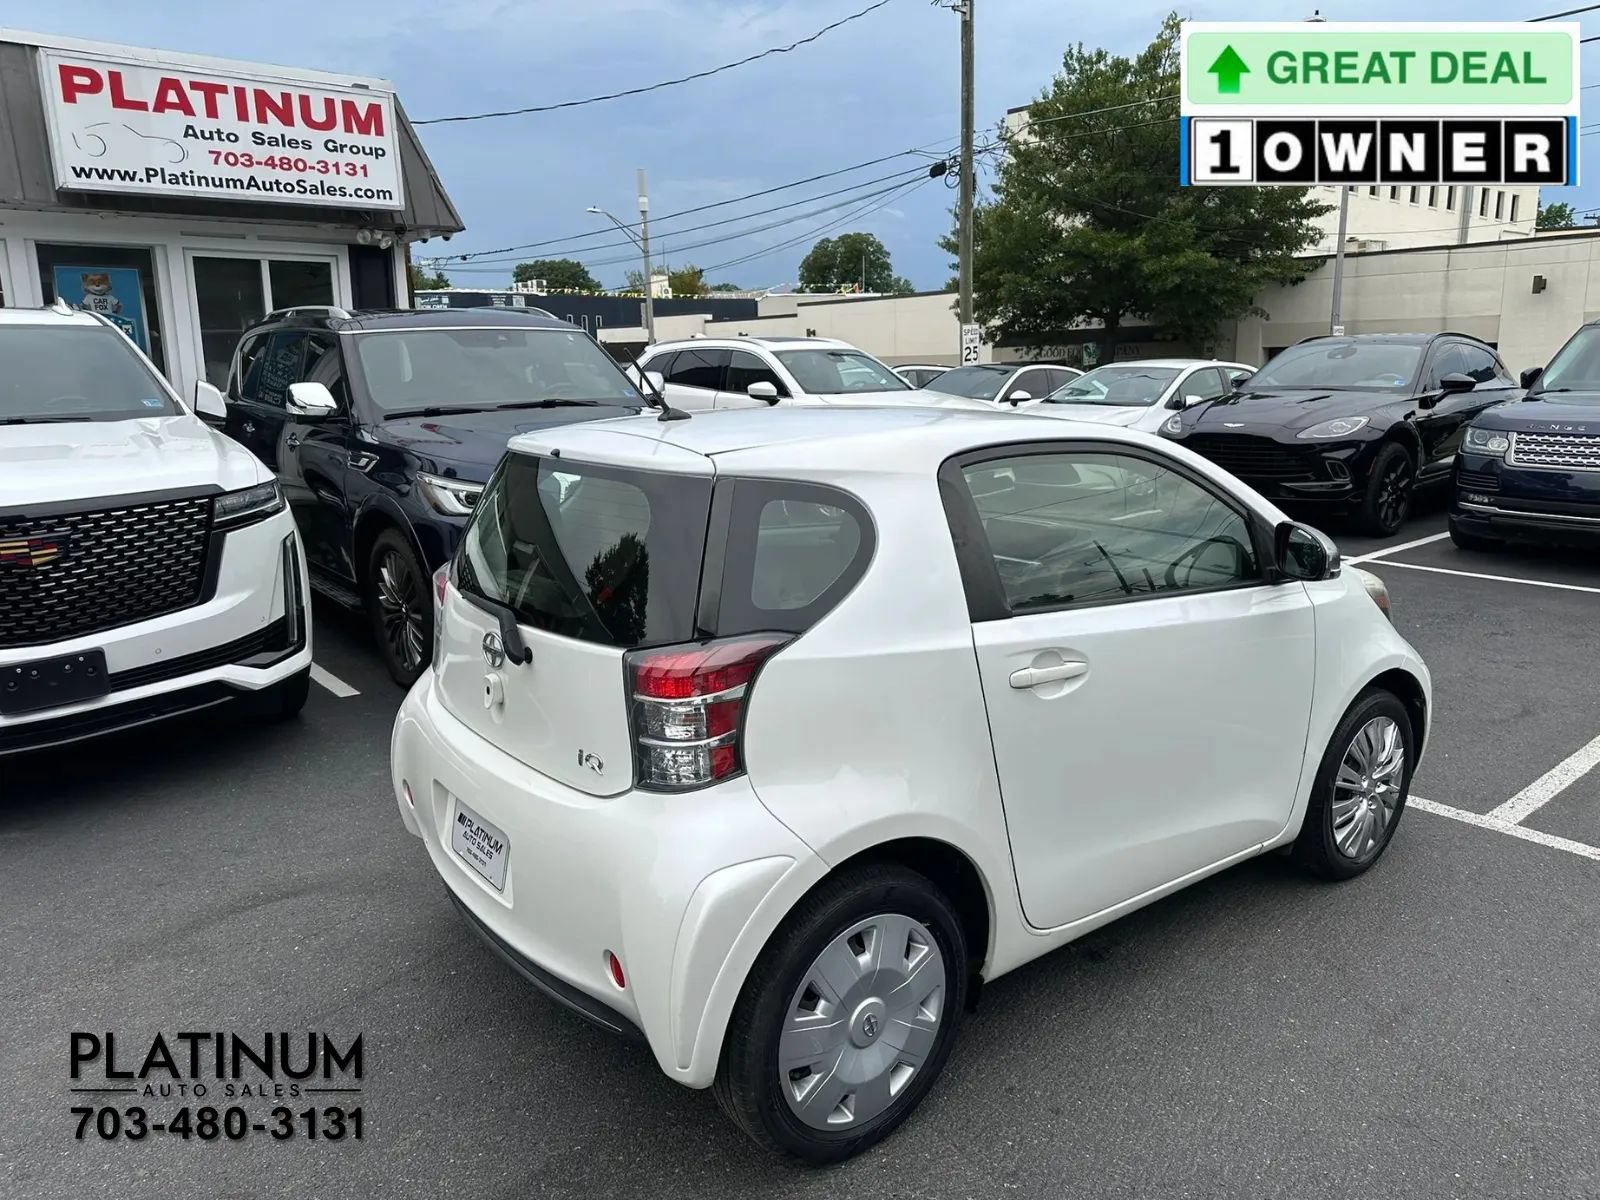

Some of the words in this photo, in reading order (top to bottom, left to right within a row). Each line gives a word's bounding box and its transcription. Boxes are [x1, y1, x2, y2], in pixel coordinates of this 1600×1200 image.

[57, 63, 385, 138] PLATINUM
[182, 124, 240, 144] Auto
[250, 131, 313, 151] Sales
[322, 138, 387, 160] Group
[207, 149, 369, 178] 703-480-3131
[70, 165, 394, 201] www.PlatinumAutoSales.com
[964, 345, 979, 362] 25
[462, 830, 477, 846] AUTO
[476, 841, 494, 860] SALES
[464, 817, 504, 856] PLATINUM
